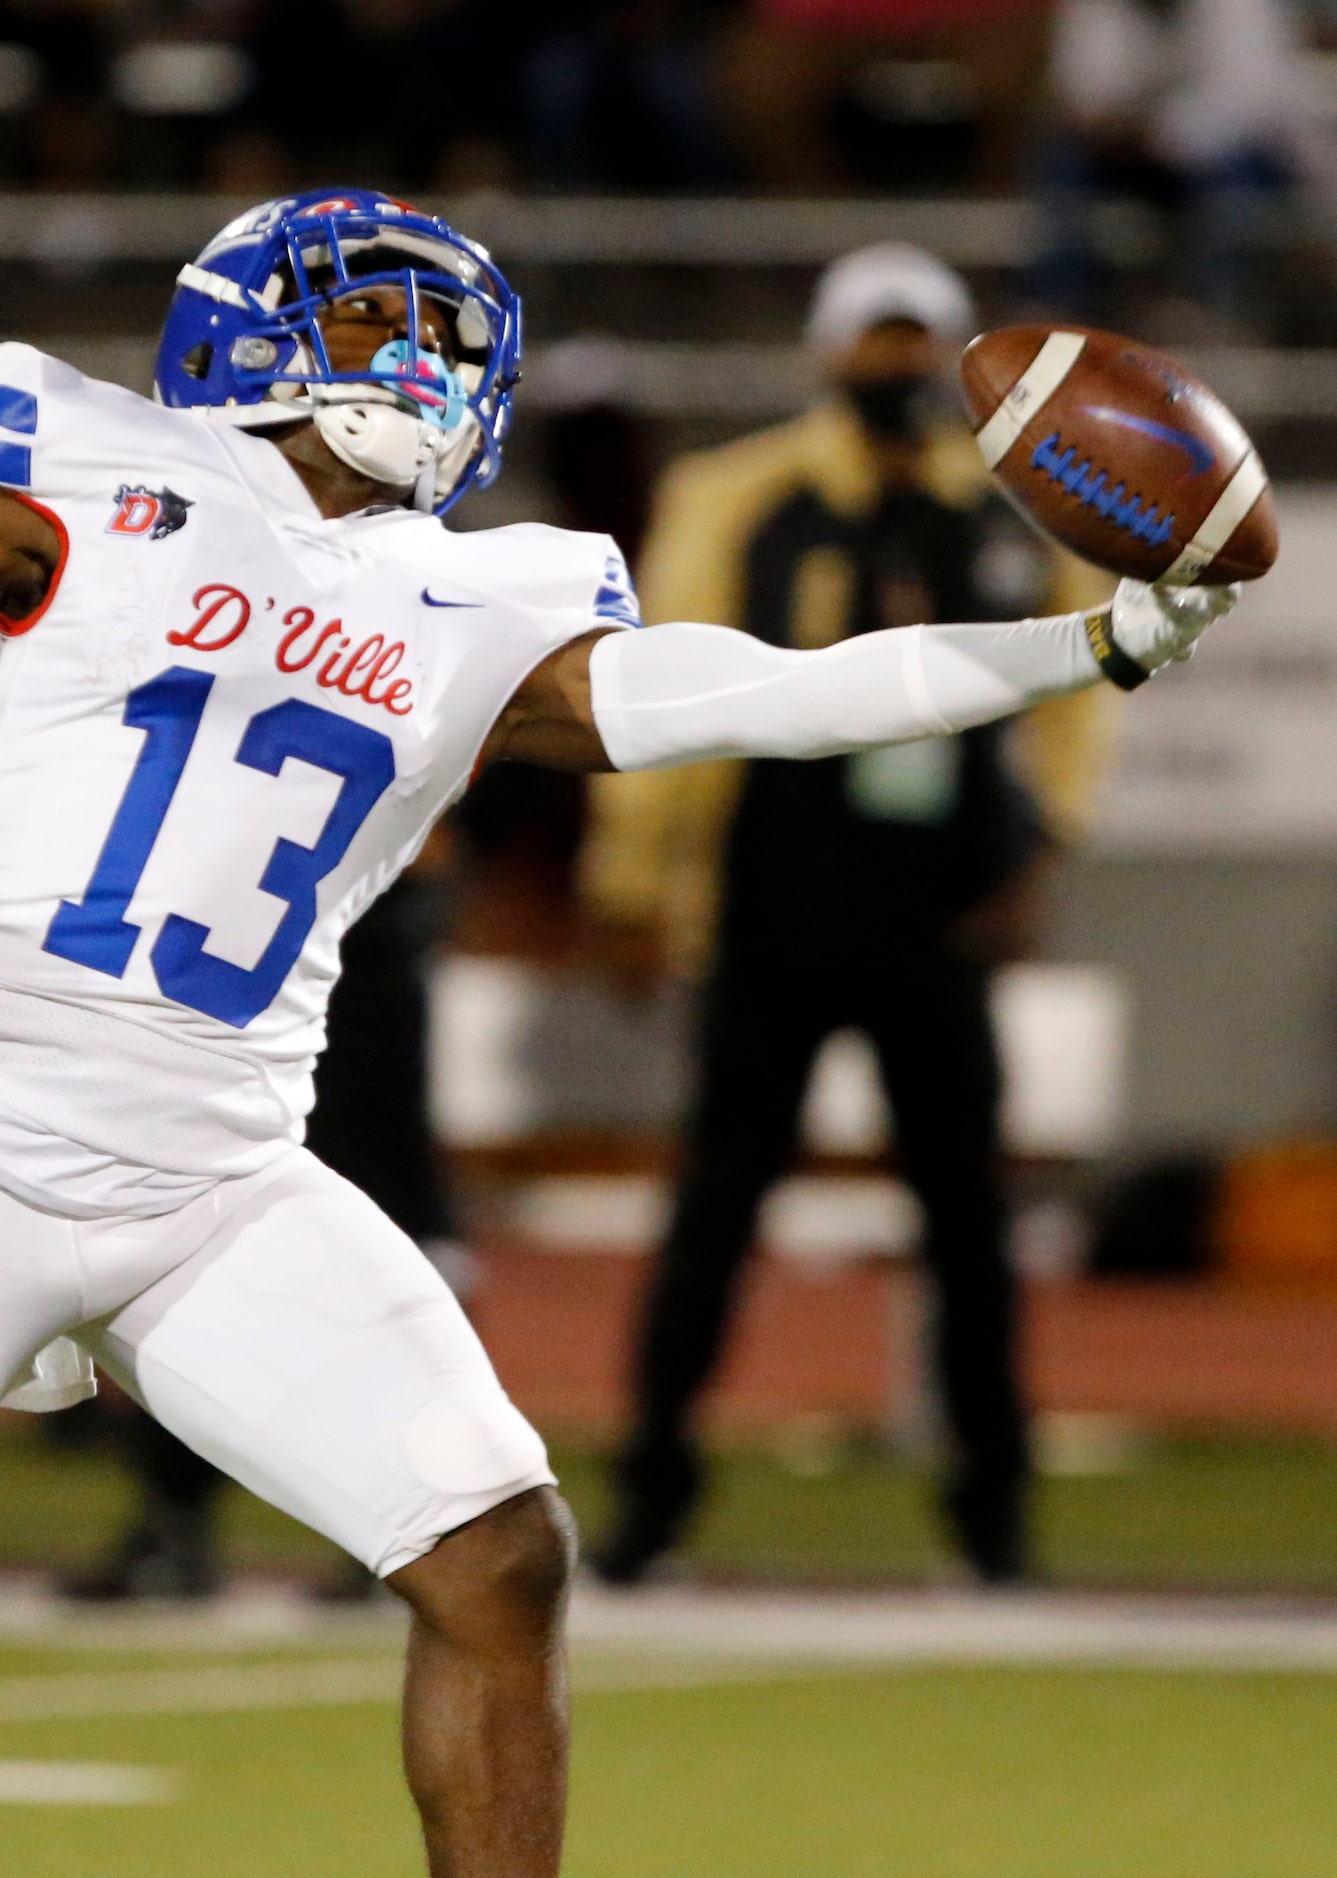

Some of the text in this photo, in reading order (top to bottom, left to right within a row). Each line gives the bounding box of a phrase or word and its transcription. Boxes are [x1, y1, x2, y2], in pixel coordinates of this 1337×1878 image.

[105, 493, 161, 536] D
[166, 583, 413, 716] D'Ville
[42, 665, 396, 1029] 13
